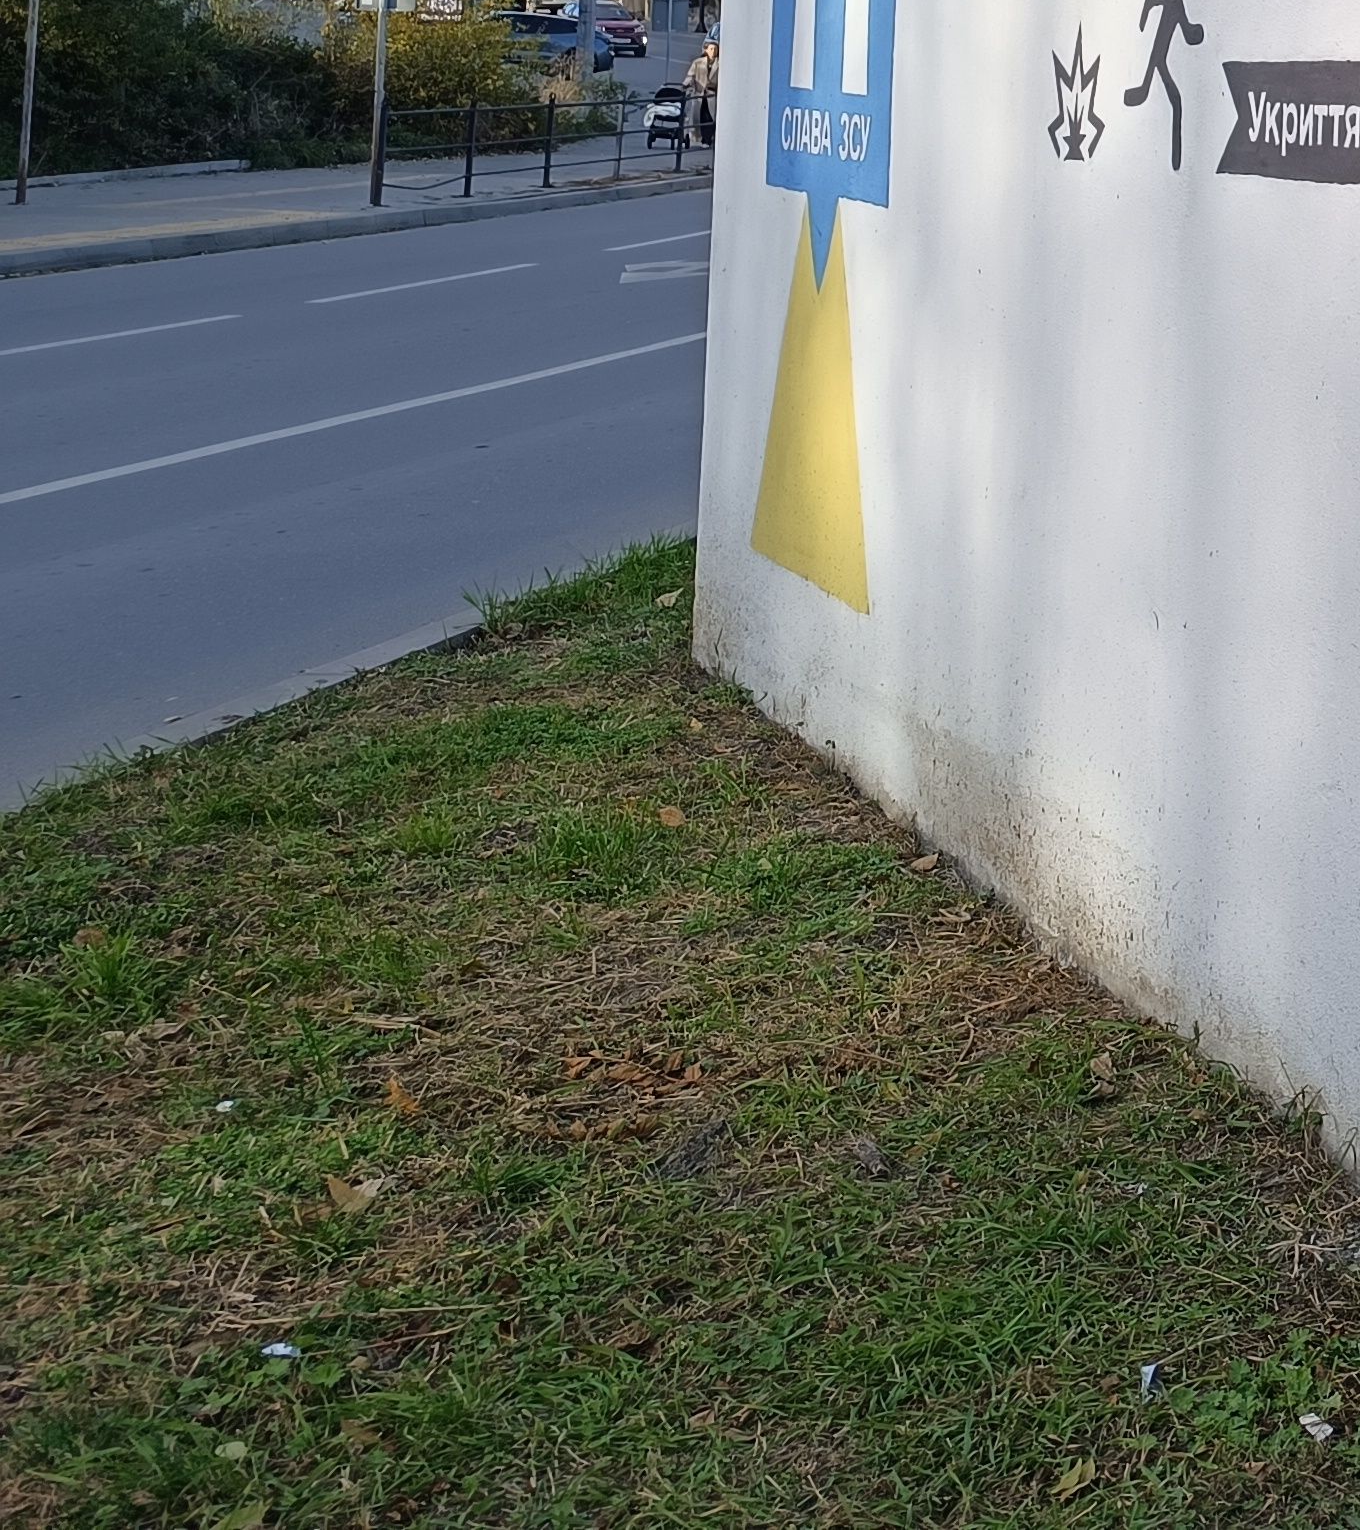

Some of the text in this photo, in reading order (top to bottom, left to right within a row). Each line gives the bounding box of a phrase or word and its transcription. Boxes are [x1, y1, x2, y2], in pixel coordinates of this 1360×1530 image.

[781, 106, 871, 162] СЛАВА ЗСУ
[1248, 91, 1360, 157] Укриття
